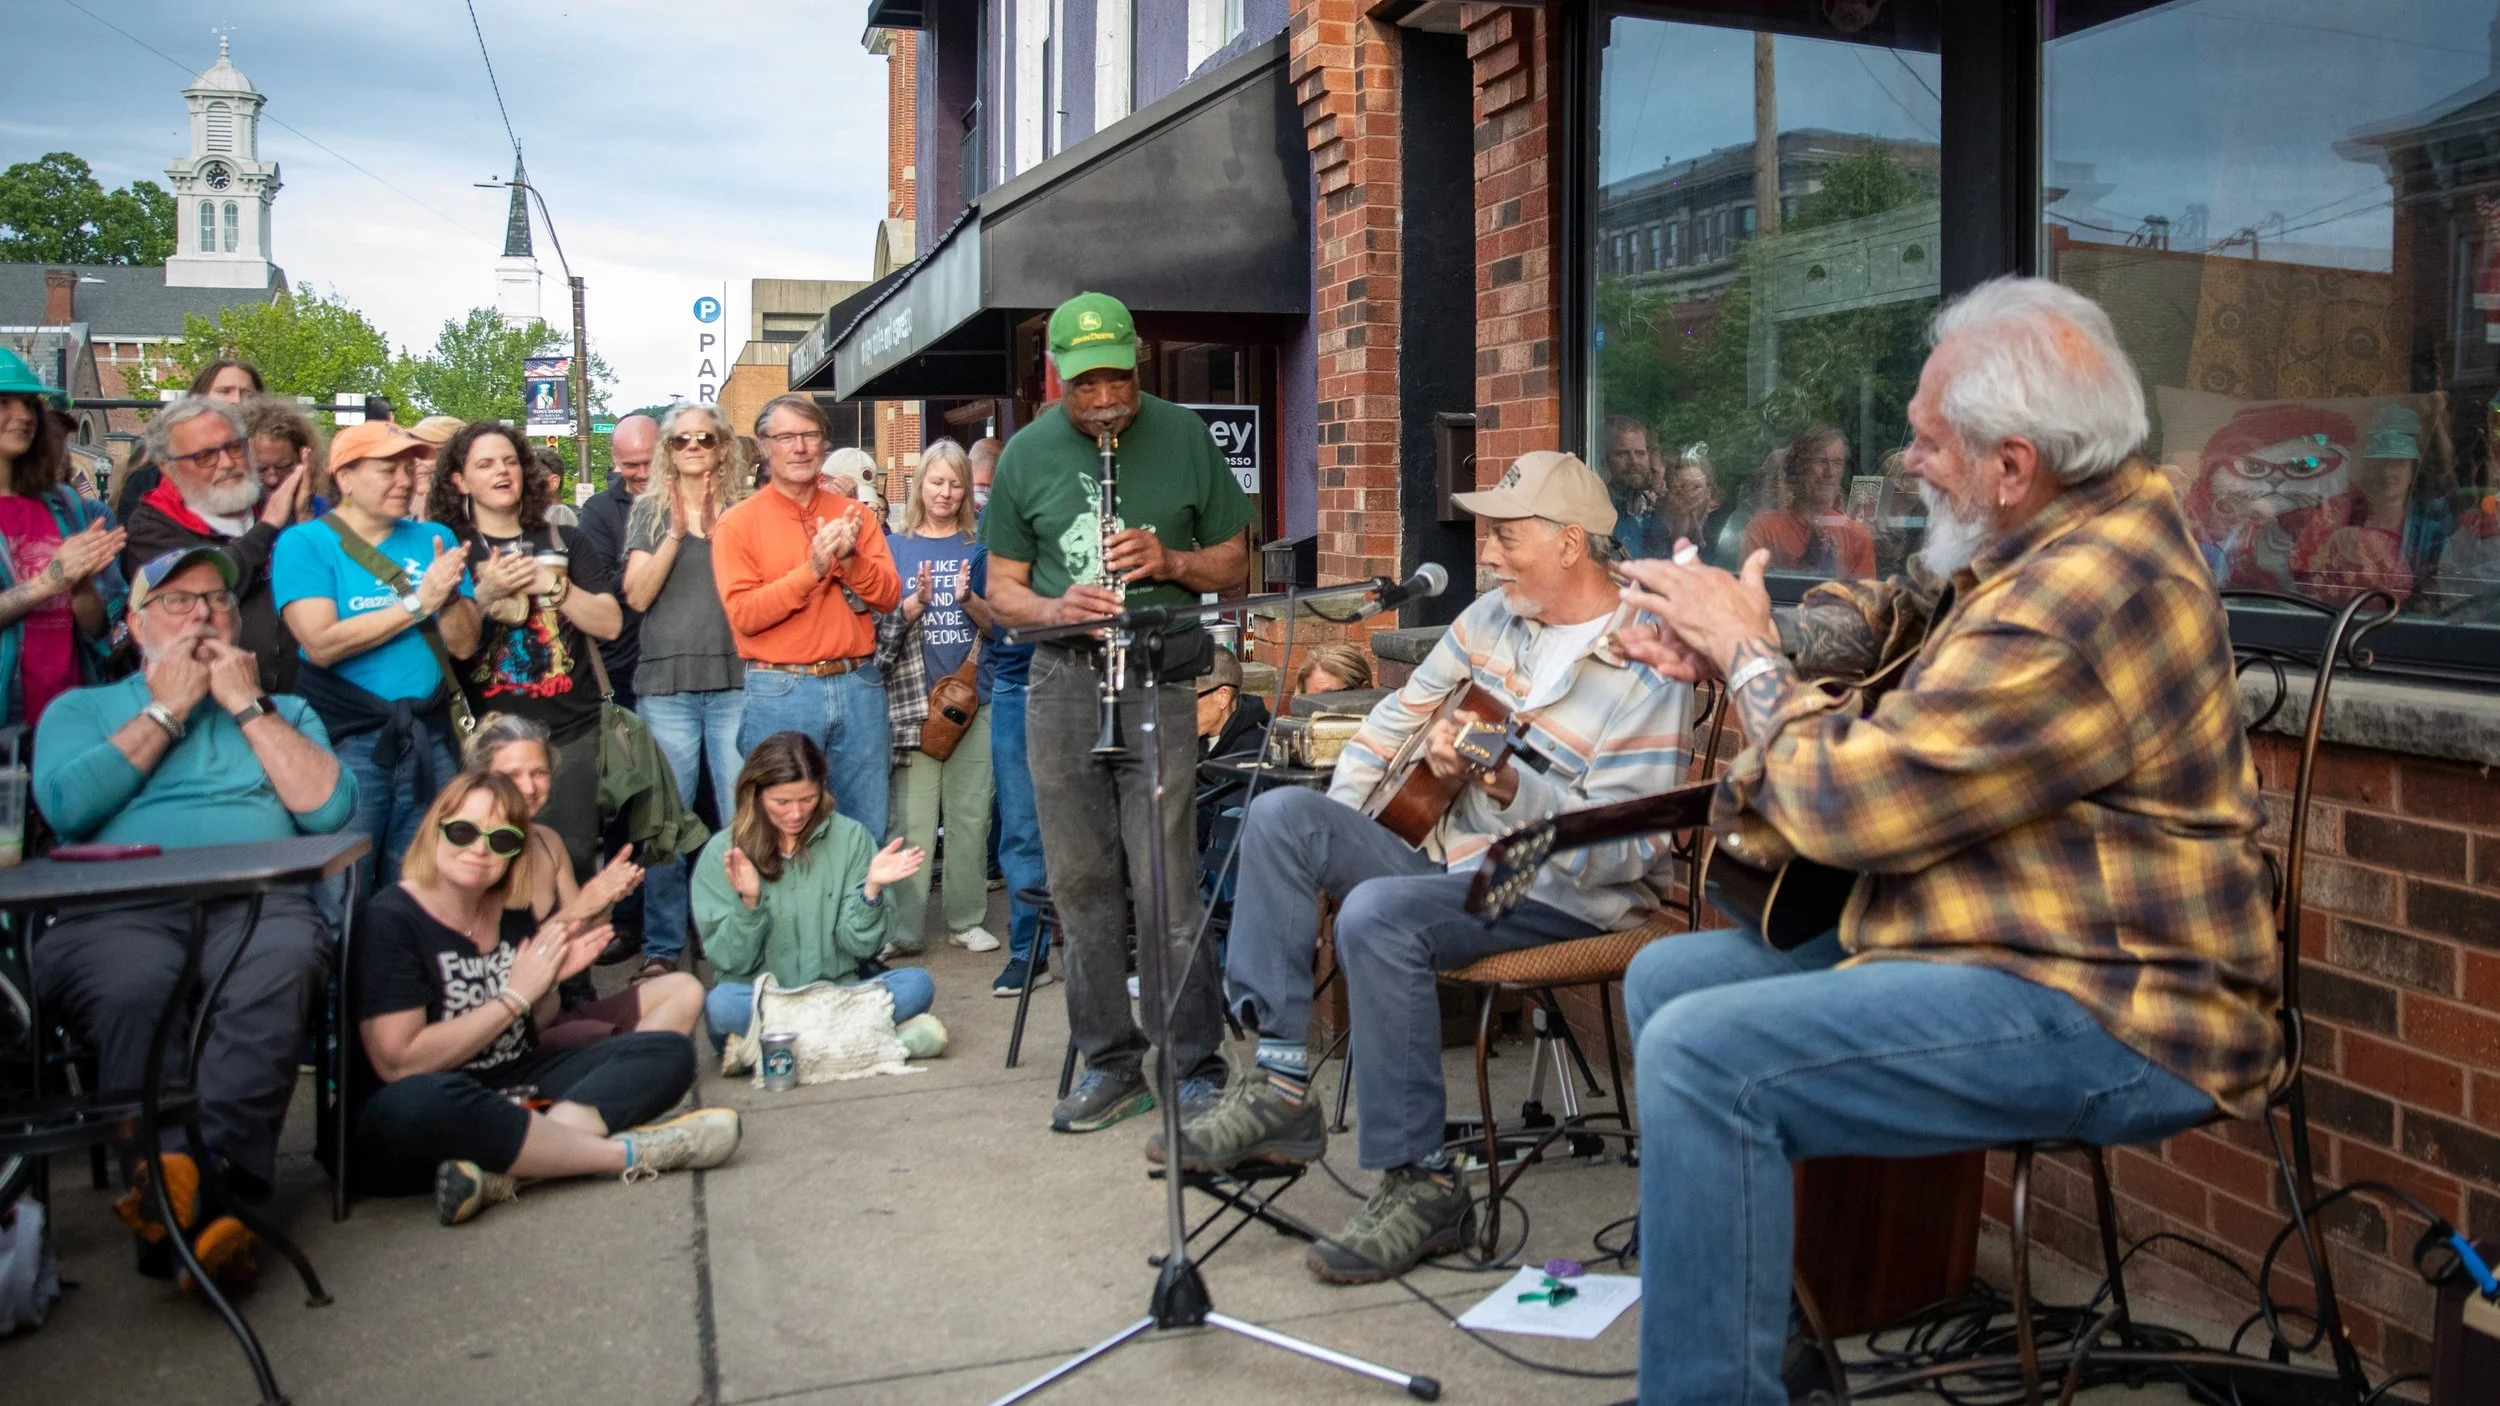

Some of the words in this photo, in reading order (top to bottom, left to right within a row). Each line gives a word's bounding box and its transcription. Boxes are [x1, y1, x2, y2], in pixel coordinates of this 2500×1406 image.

[700, 301, 717, 319] P
[1209, 420, 1253, 454] ey
[931, 592, 953, 606] ND
